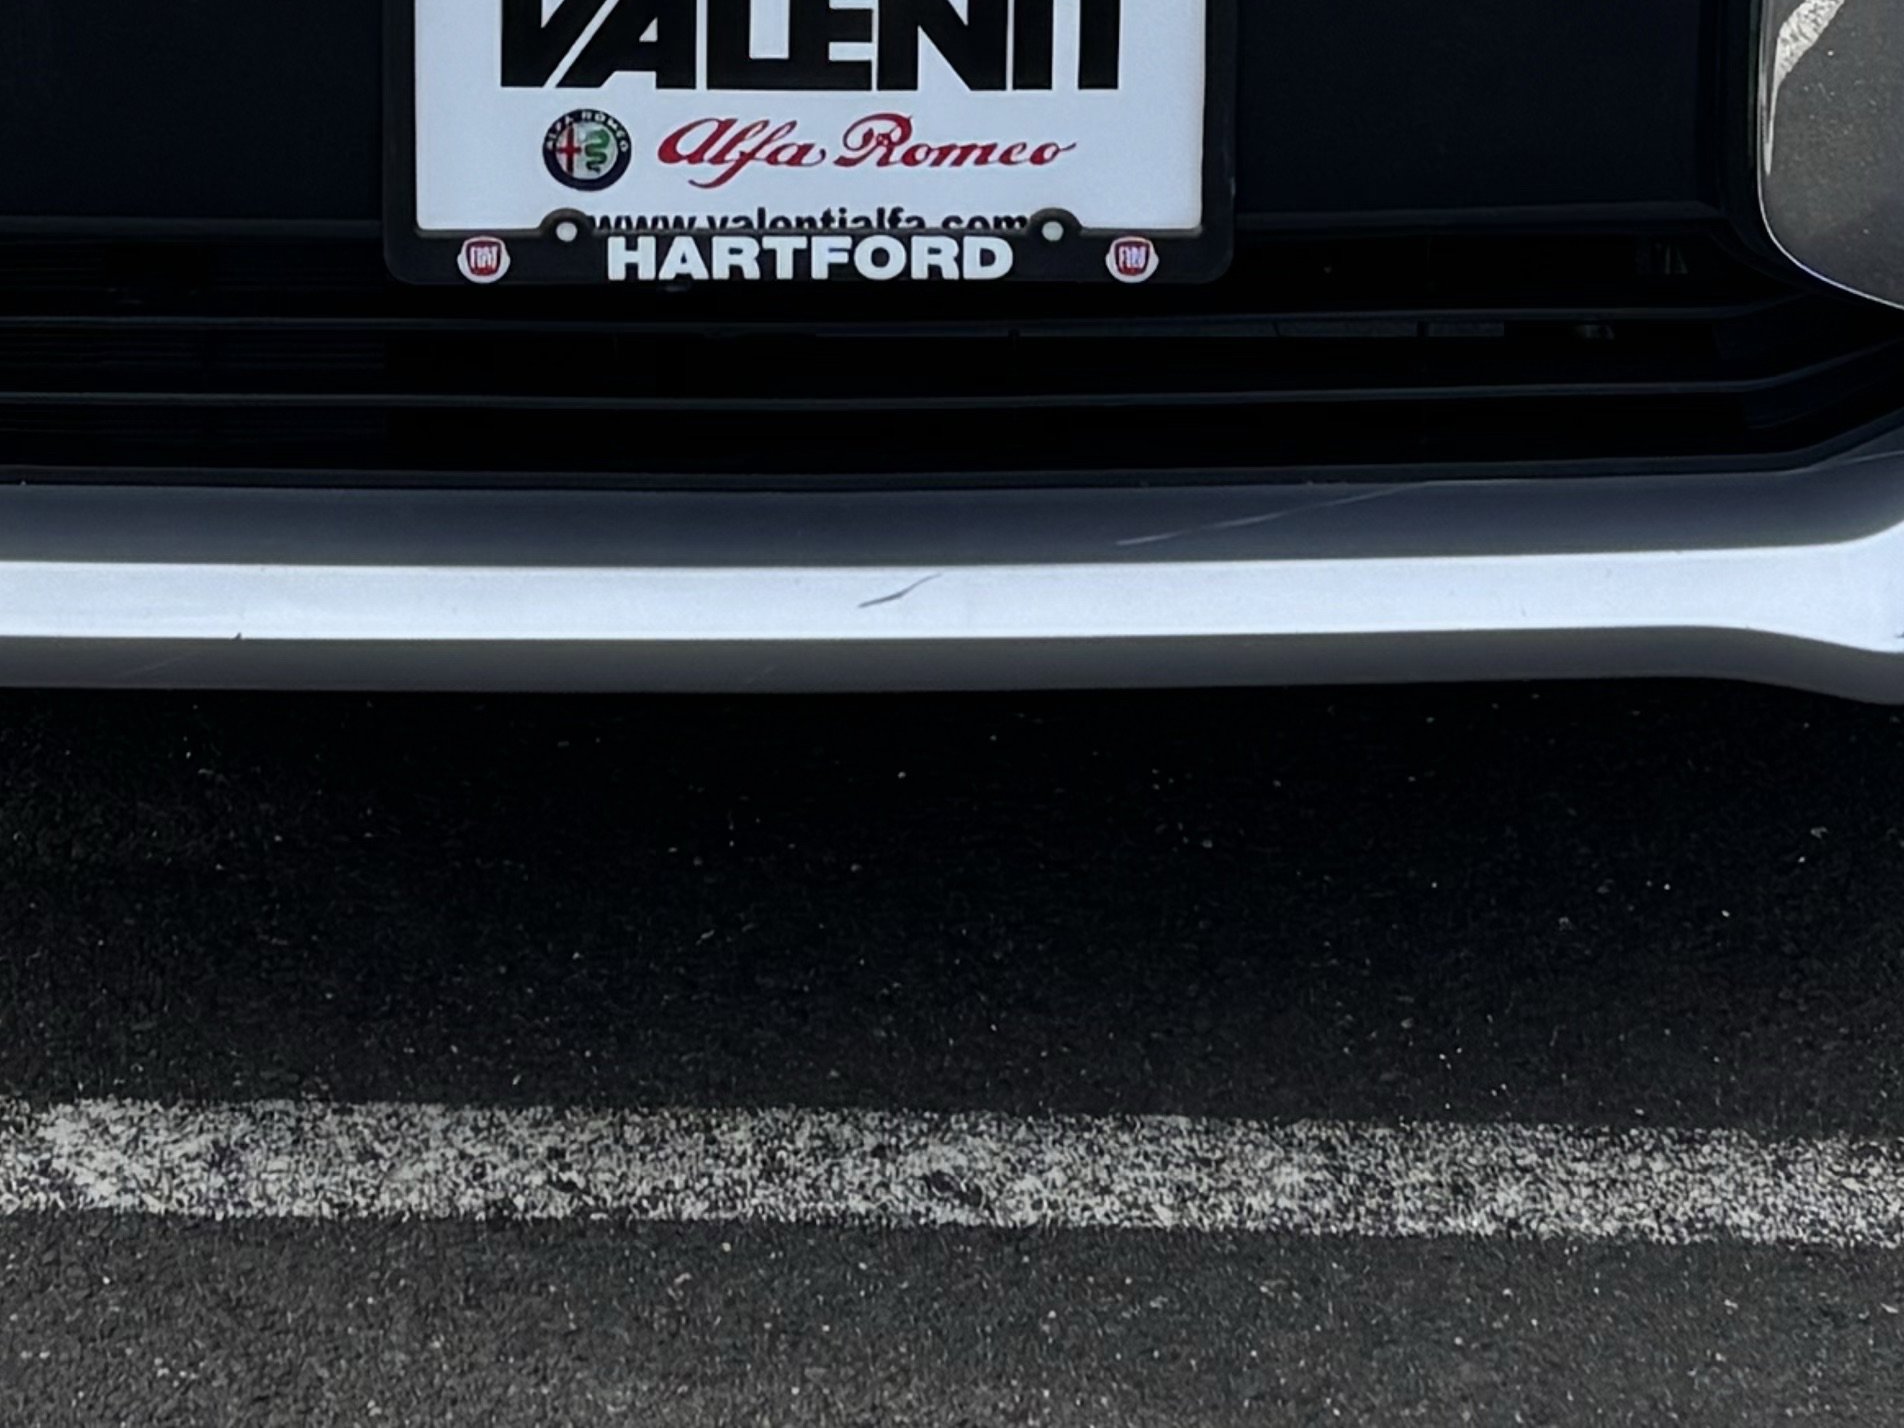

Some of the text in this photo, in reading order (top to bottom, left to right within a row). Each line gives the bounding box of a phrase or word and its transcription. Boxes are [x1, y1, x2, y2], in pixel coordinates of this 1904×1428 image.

[657, 112, 1078, 190] Alfa Romeo
[586, 206, 1028, 230] wwwvalentialfacom
[606, 236, 1014, 281] HARTFORD
